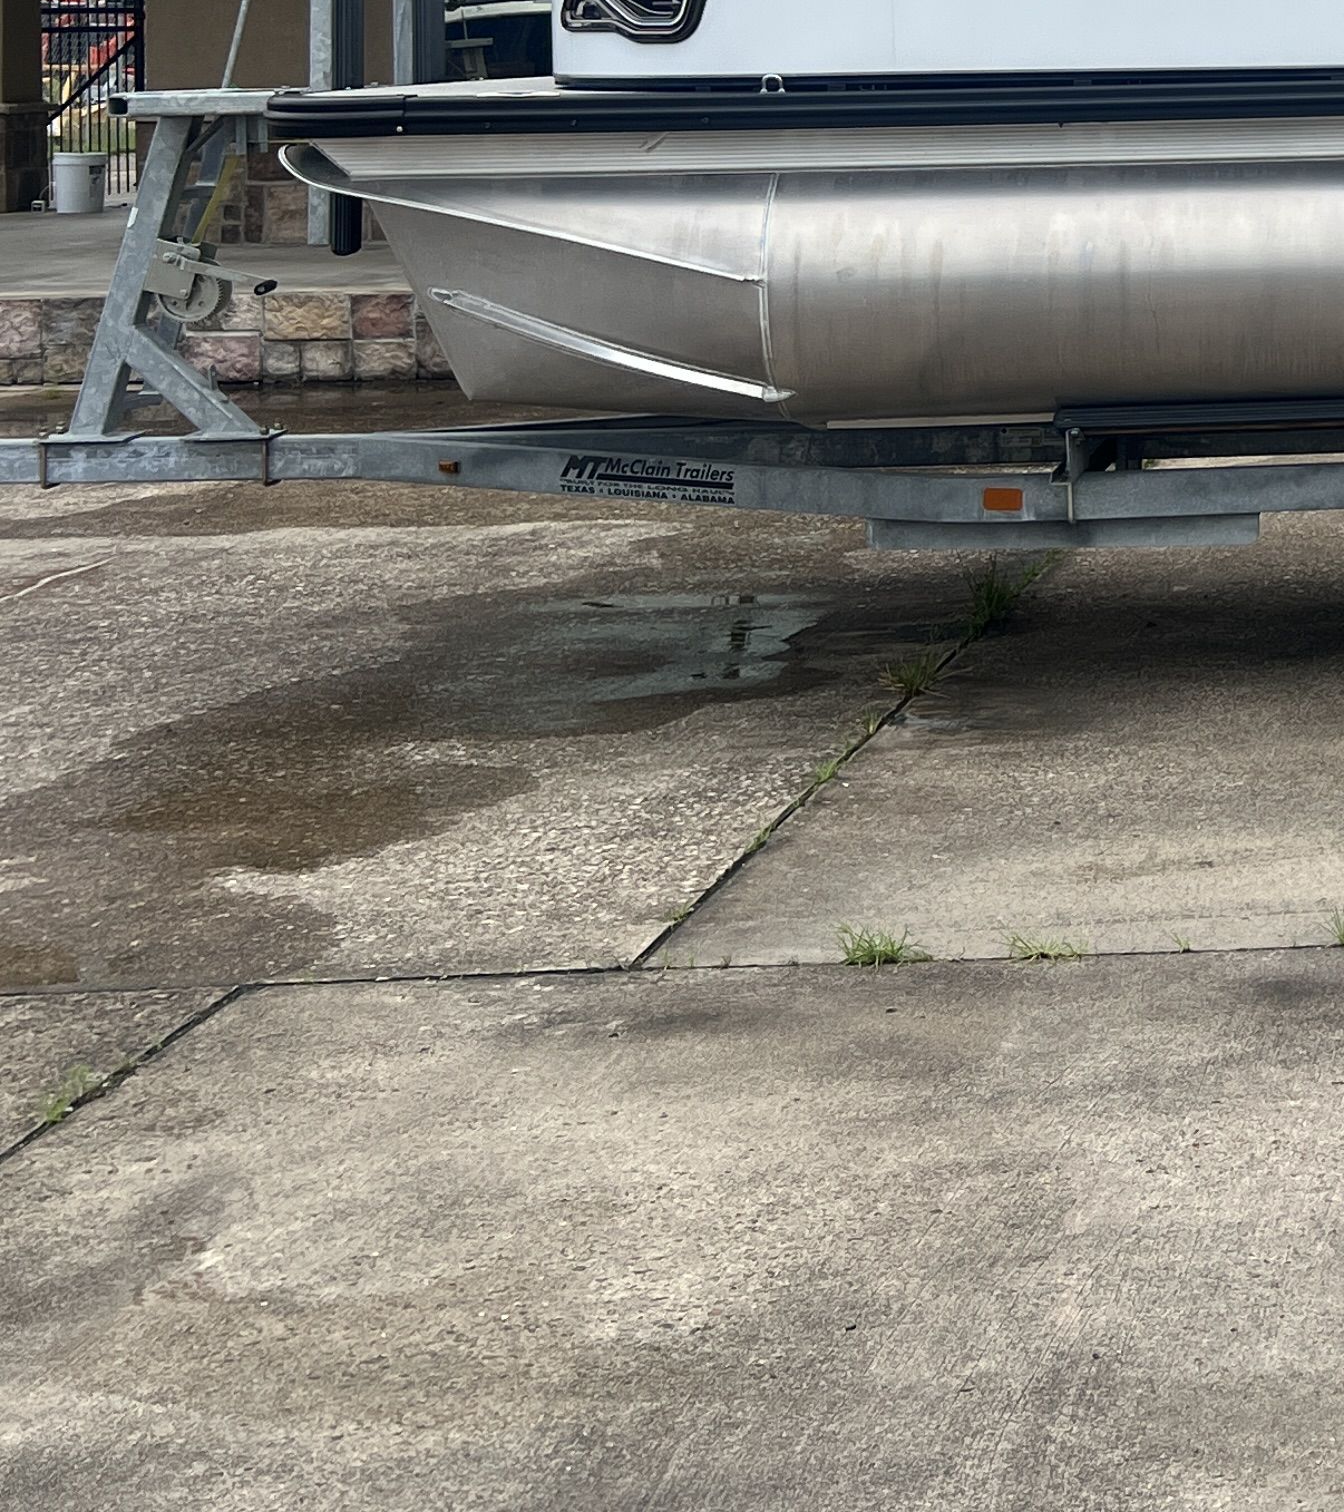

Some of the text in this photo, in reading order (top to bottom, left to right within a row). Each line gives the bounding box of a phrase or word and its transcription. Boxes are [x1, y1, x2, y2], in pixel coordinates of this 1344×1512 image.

[604, 457, 671, 477] McClain
[676, 461, 735, 482] Trailers
[560, 484, 735, 504] TEXAS LOUISIANA ALABAMA
